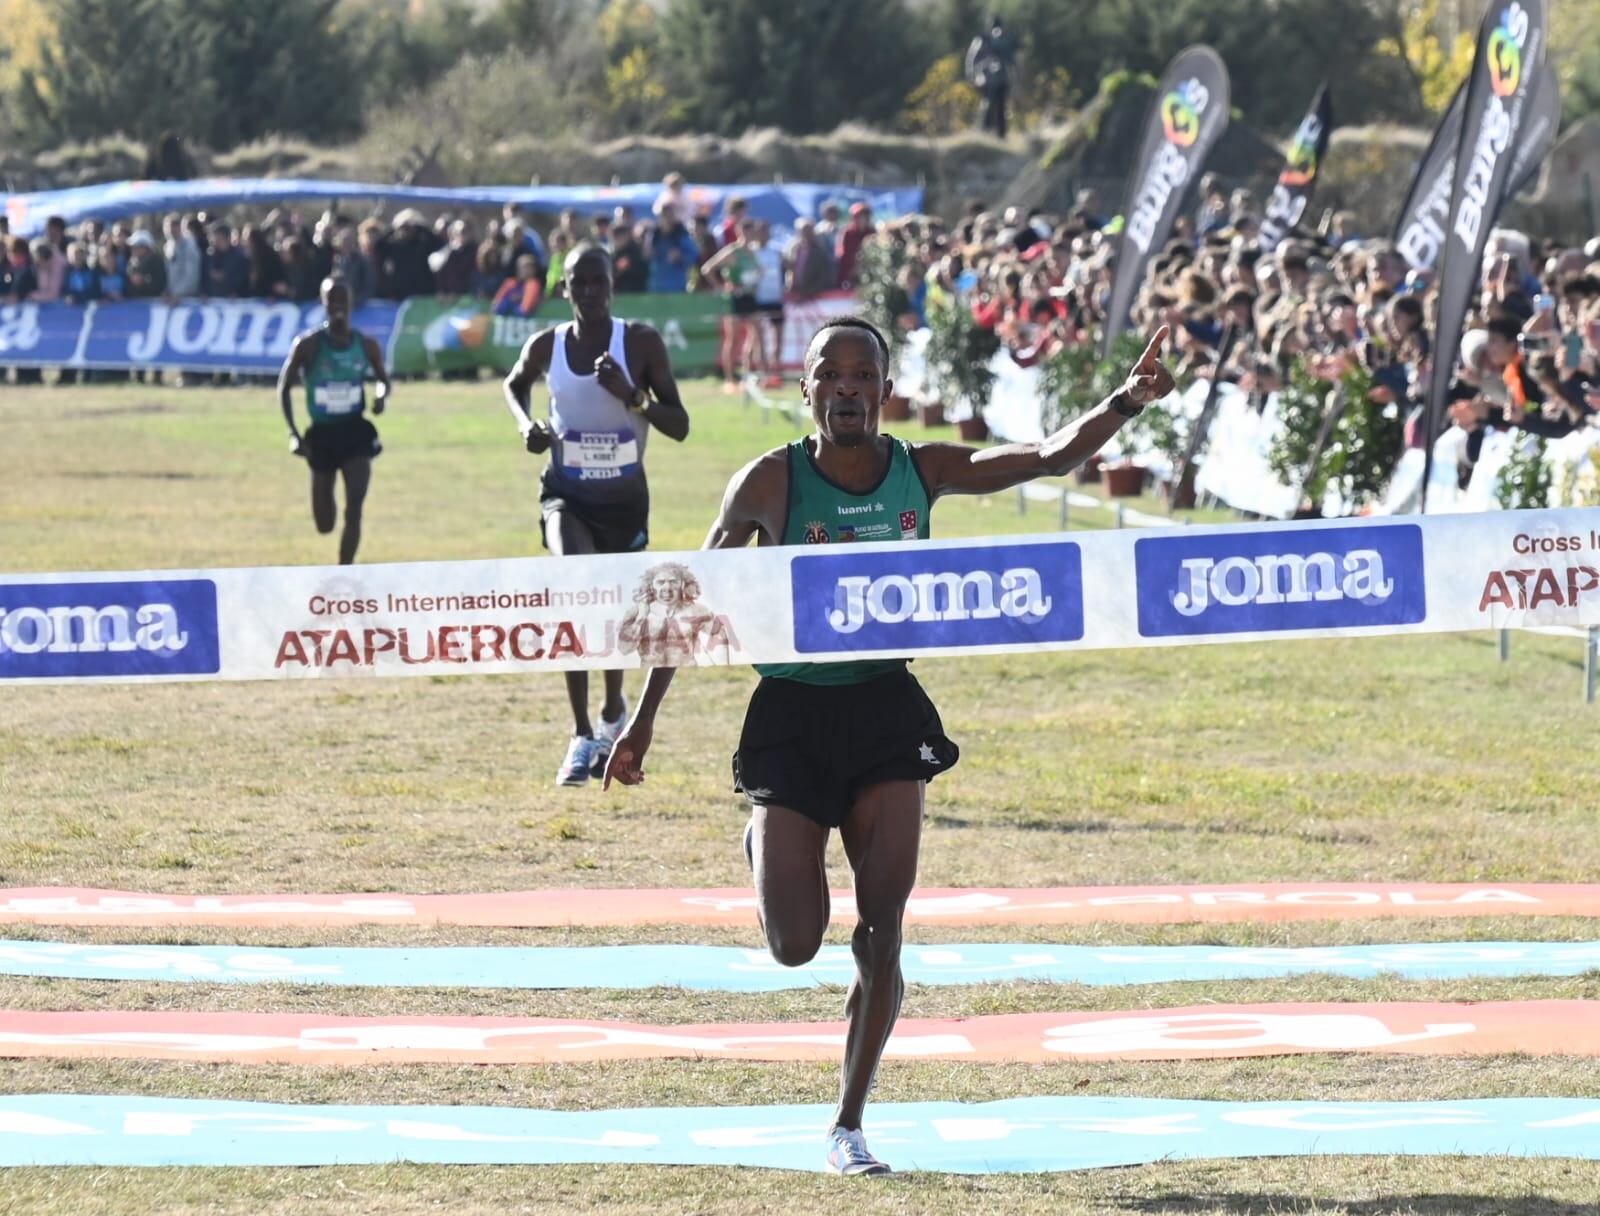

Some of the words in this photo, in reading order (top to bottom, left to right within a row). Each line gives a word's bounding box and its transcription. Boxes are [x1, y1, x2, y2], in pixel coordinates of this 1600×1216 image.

[837, 503, 872, 516] luanvi
[1511, 532, 1583, 554] Cross
[308, 594, 379, 616] Cross
[387, 587, 551, 613] Internacional
[1478, 565, 1600, 613] ATAP
[0, 602, 189, 655] oma
[273, 620, 586, 670] ATAPUERCA
